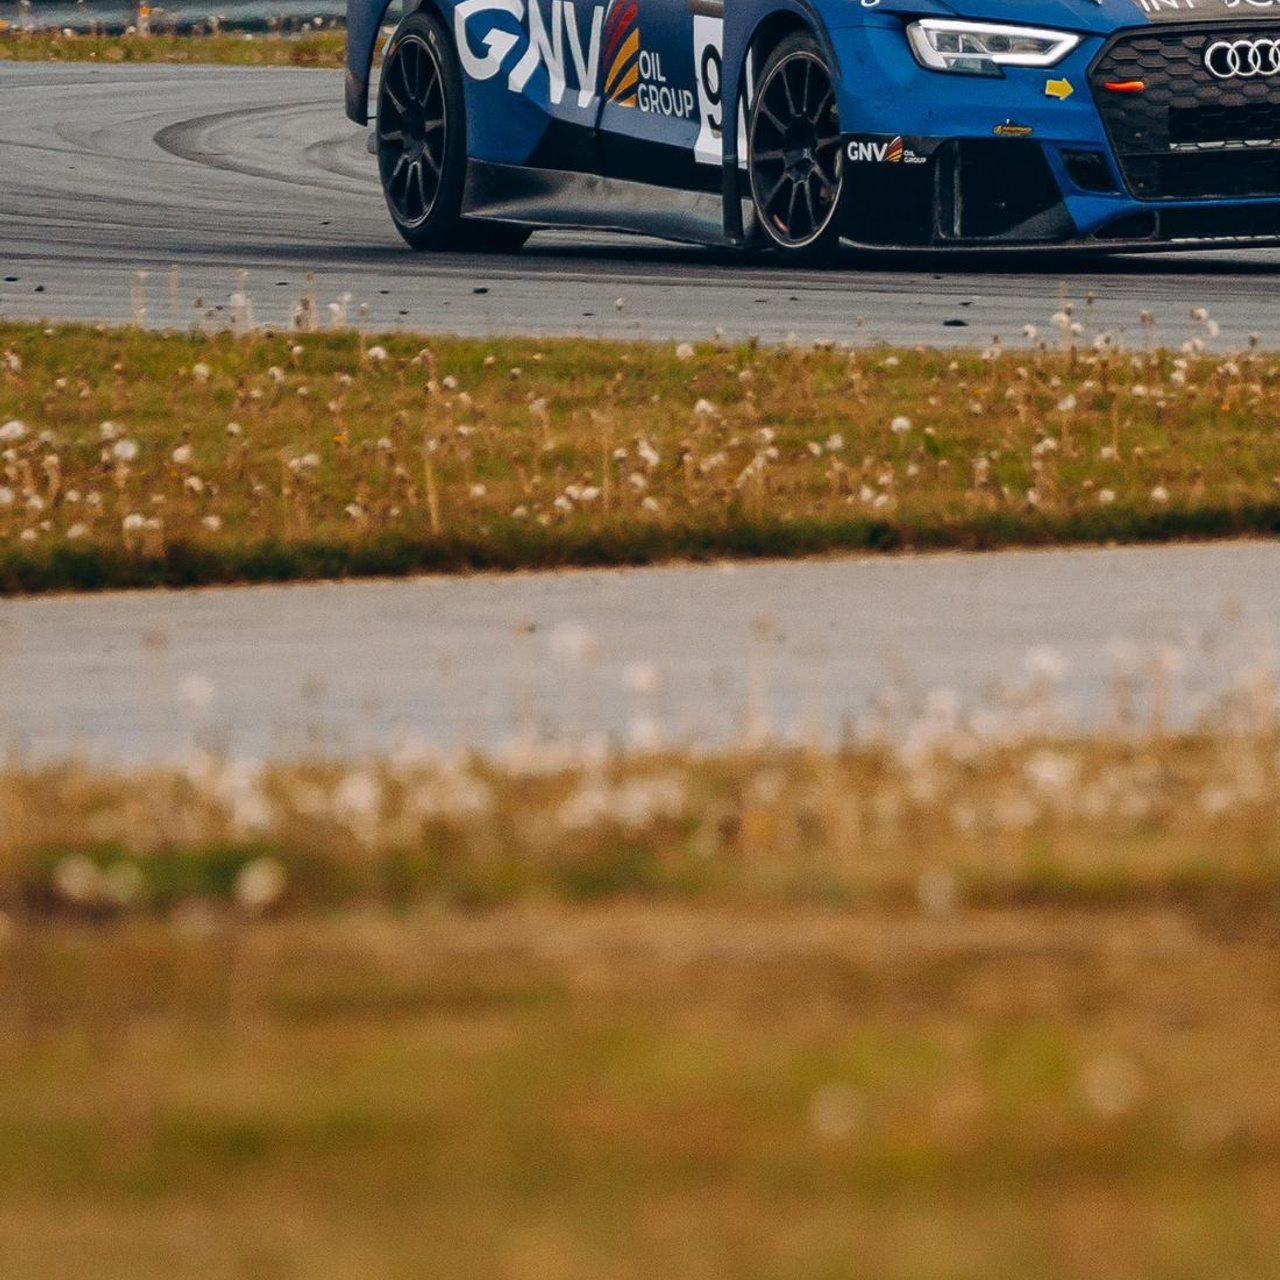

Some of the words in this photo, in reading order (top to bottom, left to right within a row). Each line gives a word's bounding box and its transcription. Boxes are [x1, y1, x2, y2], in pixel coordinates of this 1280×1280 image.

[639, 50, 667, 82] OIL
[637, 84, 694, 118] GROUP
[847, 141, 888, 162] GNV
